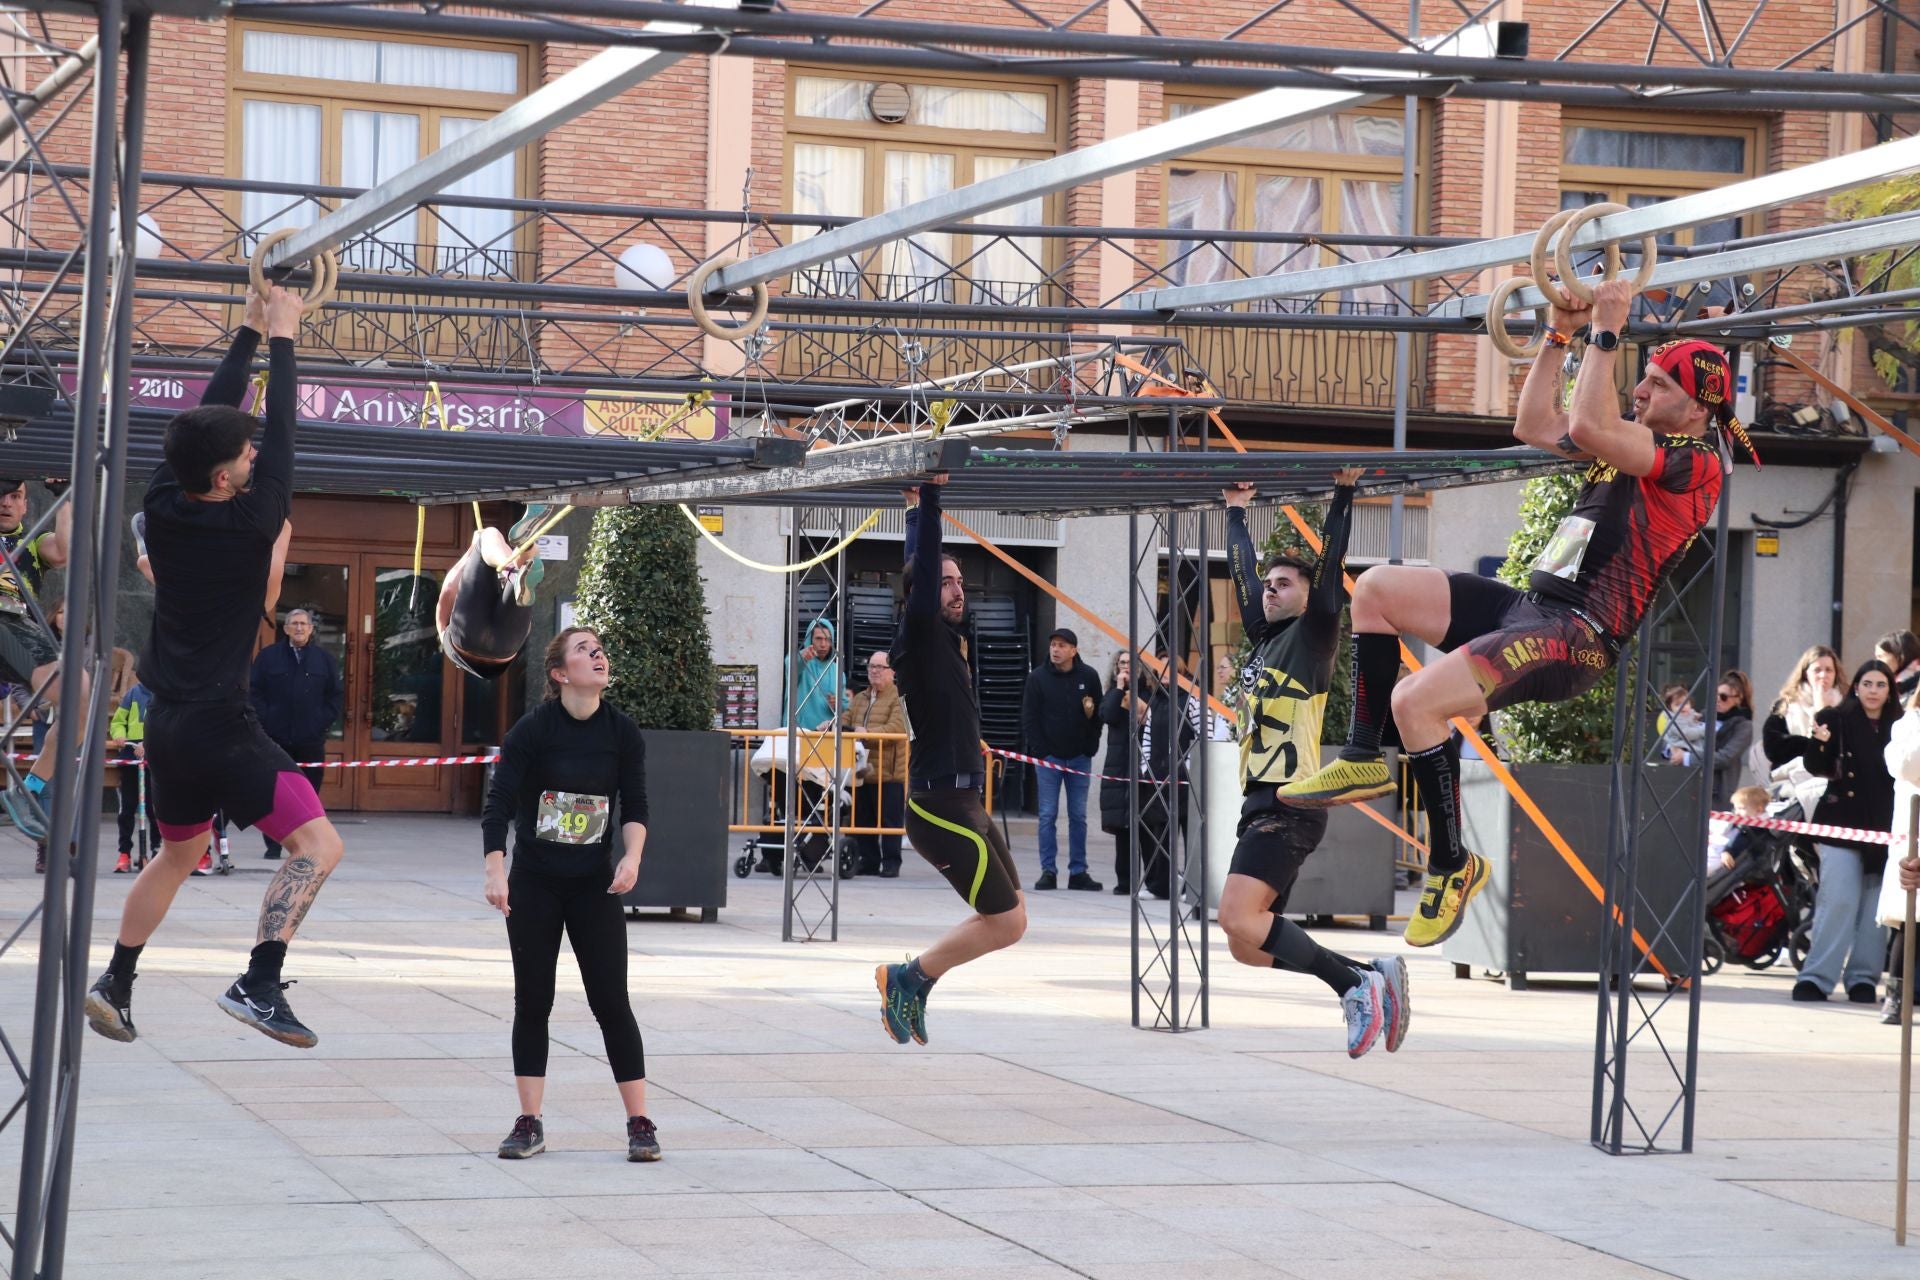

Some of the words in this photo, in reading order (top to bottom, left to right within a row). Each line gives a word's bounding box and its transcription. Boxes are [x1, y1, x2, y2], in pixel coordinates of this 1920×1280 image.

[139, 378, 184, 398] 2010
[331, 389, 545, 433] Aniversario
[559, 812, 588, 834] 49
